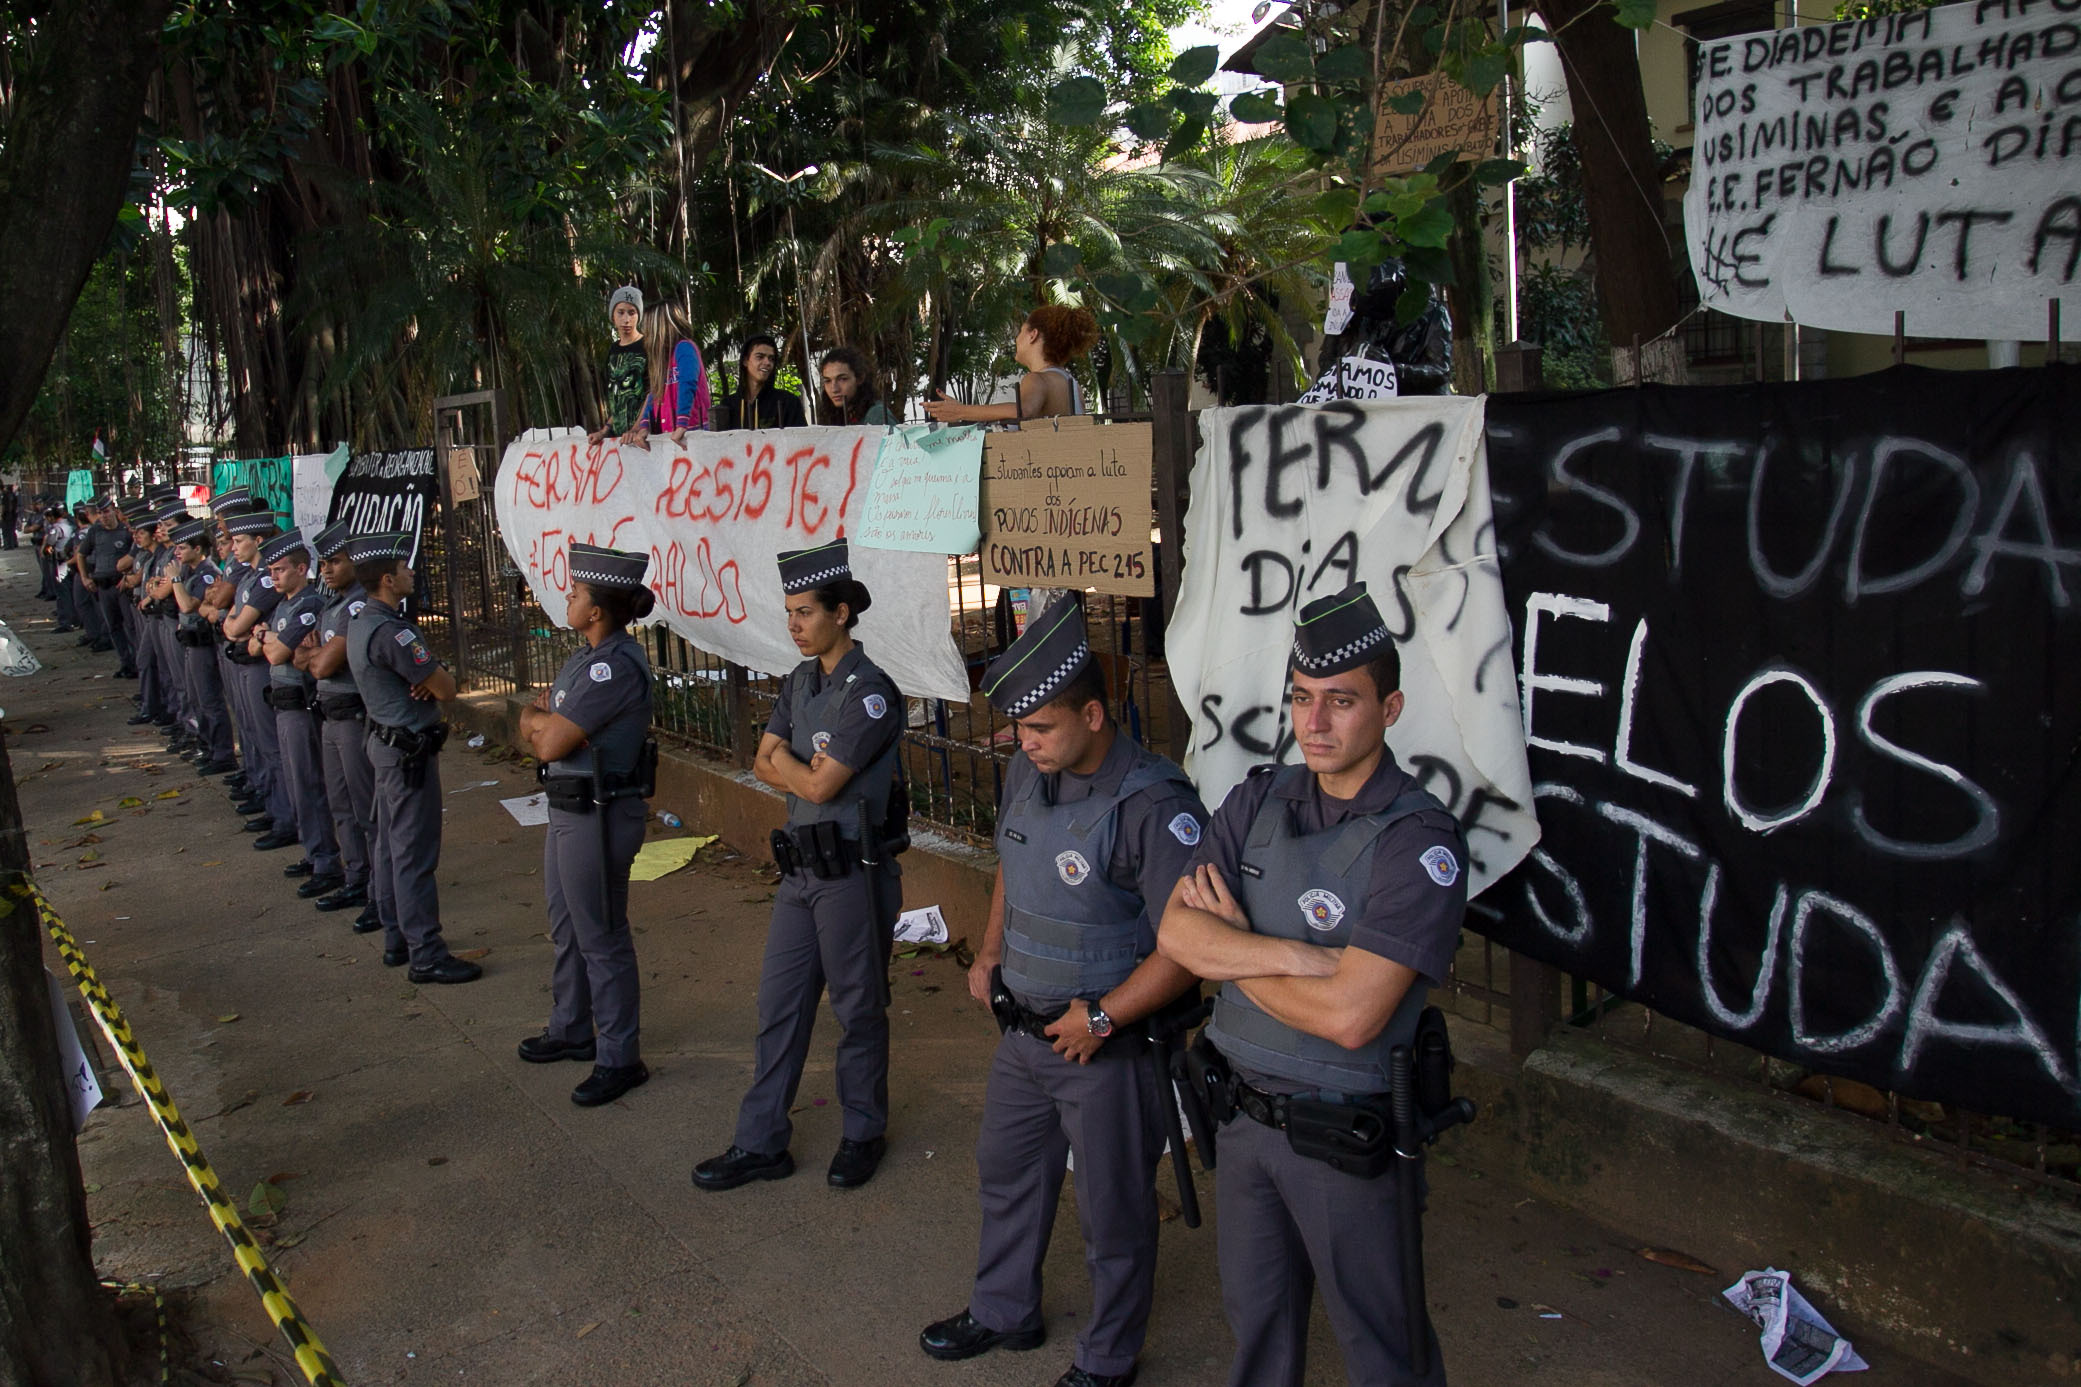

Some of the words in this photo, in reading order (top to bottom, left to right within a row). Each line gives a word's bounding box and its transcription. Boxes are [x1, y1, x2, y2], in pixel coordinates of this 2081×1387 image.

[1703, 83, 1757, 124] DOS
[1789, 23, 2081, 103] TRABALHAD
[1743, 9, 1932, 73] DIADEMA
[1448, 103, 1474, 122] DOS
[1704, 102, 1890, 167] USIMINAS
[1994, 75, 2029, 114] A
[1754, 129, 1939, 210] FERNÃO
[1819, 195, 2081, 283] LUTA
[655, 436, 864, 540] RESISTE!
[1045, 482, 1062, 507] dos
[1046, 463, 1085, 492] apoiam
[1086, 466, 1097, 478] a
[1100, 448, 1127, 478] luta
[993, 507, 1039, 534] POVOS
[1042, 497, 1122, 538] INDÍGENAS
[1486, 424, 2081, 604] STUDA
[990, 543, 1056, 578] CONTRA
[1061, 546, 1072, 577] A
[1078, 550, 1110, 577] PEC
[1113, 550, 1145, 579] 215
